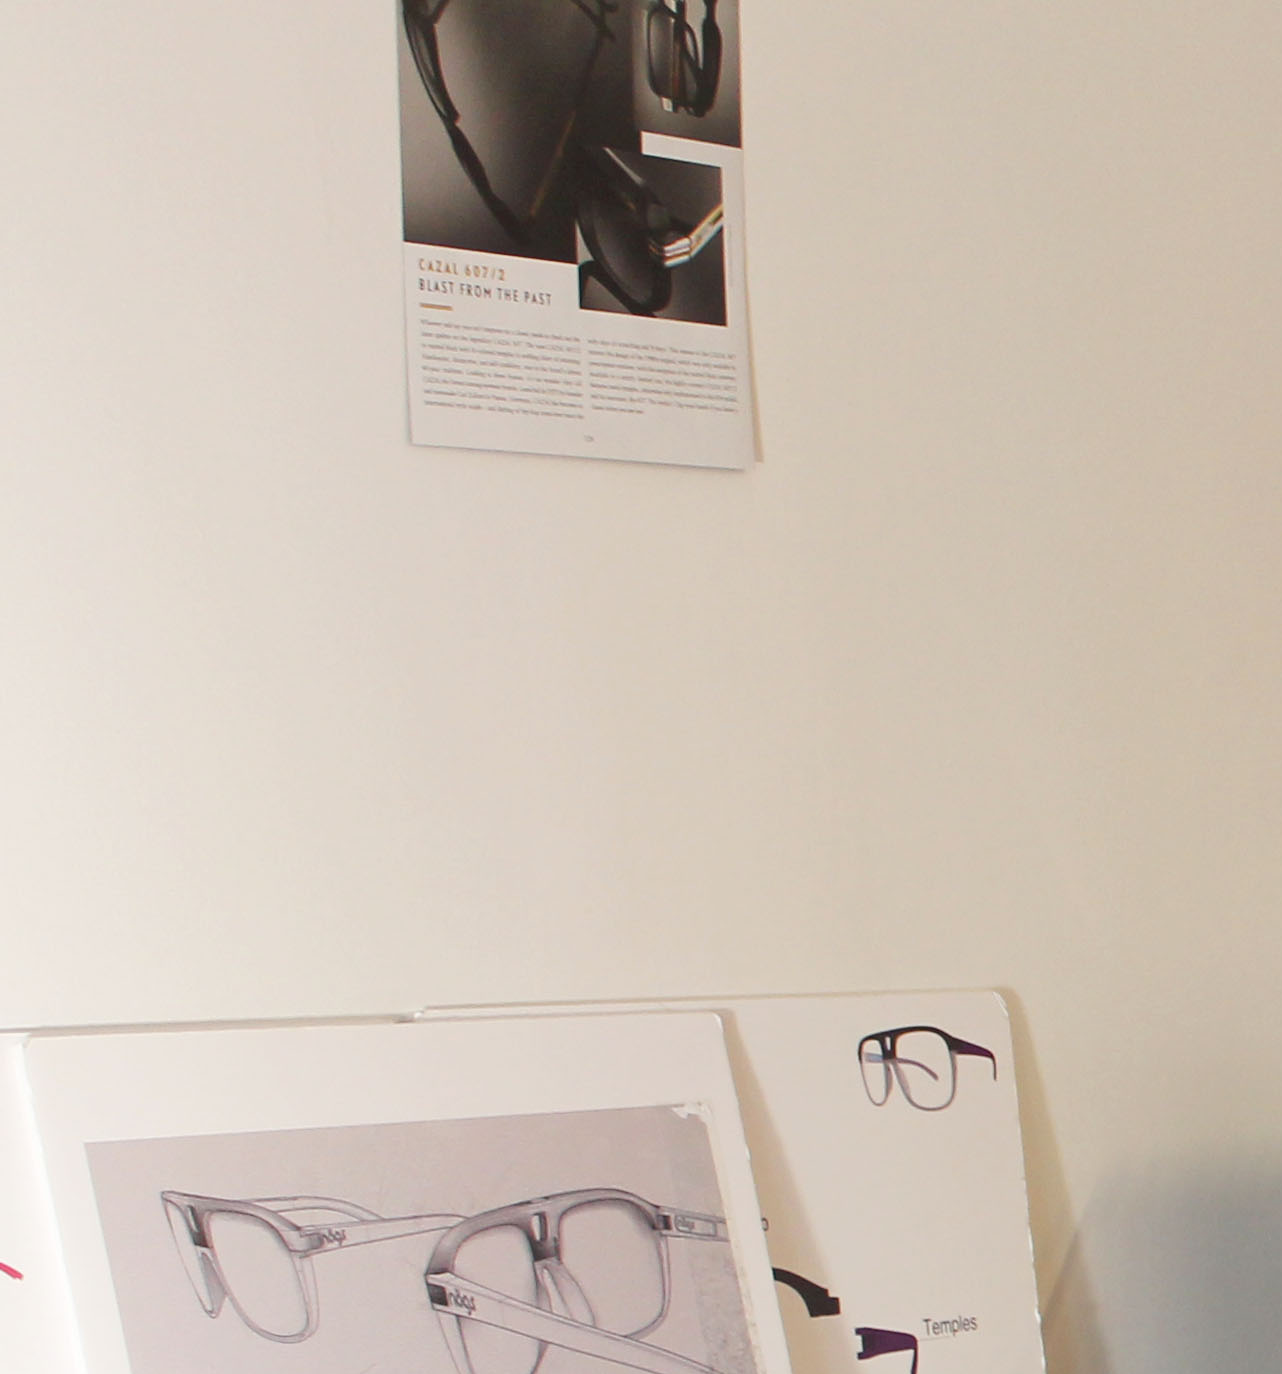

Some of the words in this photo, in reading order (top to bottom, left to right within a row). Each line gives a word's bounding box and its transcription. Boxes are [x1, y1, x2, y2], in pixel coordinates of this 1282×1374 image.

[419, 257, 459, 275] CAZAL
[418, 278, 454, 294] BLAST
[460, 283, 492, 299] FROM
[497, 287, 519, 302] THE
[524, 291, 552, 306] PAST
[923, 1315, 978, 1337] Temples
